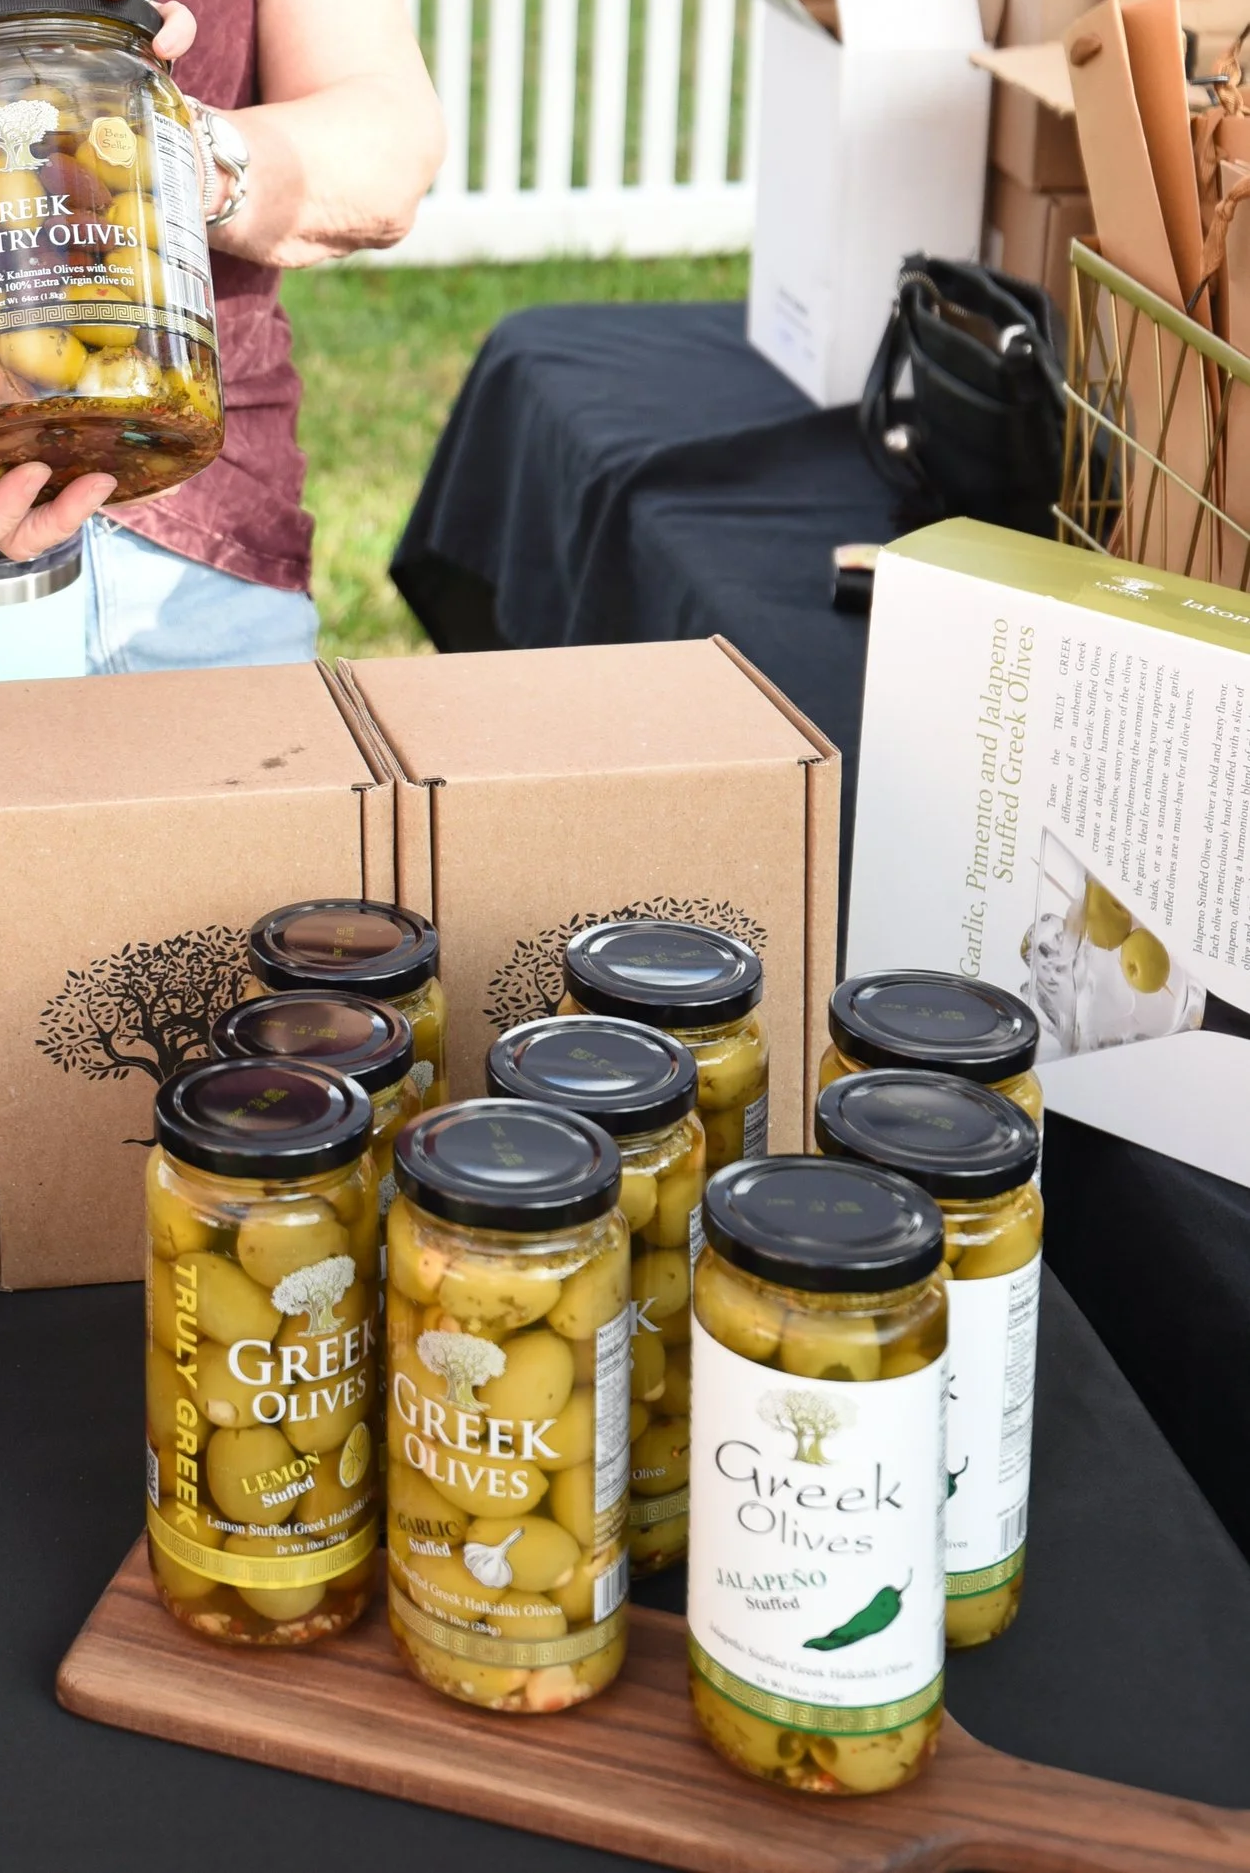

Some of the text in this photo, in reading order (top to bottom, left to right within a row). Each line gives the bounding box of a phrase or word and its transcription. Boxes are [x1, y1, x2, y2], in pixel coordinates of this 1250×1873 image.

[49, 223, 138, 248] OLIVES
[5, 280, 31, 292] 100%
[34, 278, 59, 288] Extra
[61, 276, 92, 287] Virgin
[94, 275, 119, 285] Olive
[120, 277, 134, 287] Oil
[6, 267, 51, 281] Kalamata
[53, 264, 84, 274] Olives
[86, 263, 106, 273] with
[109, 264, 134, 275] Greek
[1095, 581, 1149, 601] LAKONIA
[1122, 655, 1133, 684] olives
[1083, 645, 1102, 750] Garlic Stuffed Olives
[1232, 700, 1243, 724] slice
[1047, 636, 1072, 808] Taste the TRULY GREEK
[1061, 641, 1087, 824] difference of authentic Greek
[1118, 719, 1127, 747] notes
[1180, 722, 1191, 747] olive
[993, 626, 1035, 884] Stuffed Greek Olives
[1230, 734, 1240, 759] with
[1092, 707, 1114, 853] create delightful harmony
[1158, 773, 1170, 829] standalone
[1165, 702, 1177, 730] these
[959, 618, 1010, 978] Garlic, Pimento and Jalapeno
[1117, 839, 1134, 883] perfectly
[1134, 694, 1145, 737] aromatic
[1104, 845, 1115, 867] with
[1193, 742, 1221, 954] Jalapeno Stuffed Olives deliver bold and
[1166, 860, 1178, 890] olives
[1163, 889, 1175, 926] stuffed
[1230, 875, 1244, 916] offering
[1211, 908, 1222, 932] olive
[1209, 935, 1220, 959] Each
[228, 1311, 376, 1386] GREEK
[175, 1263, 198, 1535] TRULY GREEK
[252, 1368, 366, 1424] OLIVES
[393, 1371, 561, 1461] GREEK
[241, 1450, 321, 1496] LEMON
[404, 1432, 530, 1500] OLIVES
[633, 1465, 666, 1480] Olives
[715, 1440, 903, 1513] Greek
[261, 1474, 315, 1509] Stuffed
[207, 1515, 246, 1534] Lemon
[250, 1523, 292, 1537] Stuffed
[294, 1518, 326, 1534] Greek
[398, 1512, 458, 1538] GARLIC
[737, 1500, 873, 1554] Olives
[408, 1537, 452, 1558] Stuffed
[715, 1567, 828, 1593] JALAPEÑO
[430, 1582, 462, 1608] Greek
[464, 1595, 521, 1617] Halkidiki
[523, 1603, 562, 1617] Olives
[745, 1594, 801, 1612] Stuffed
